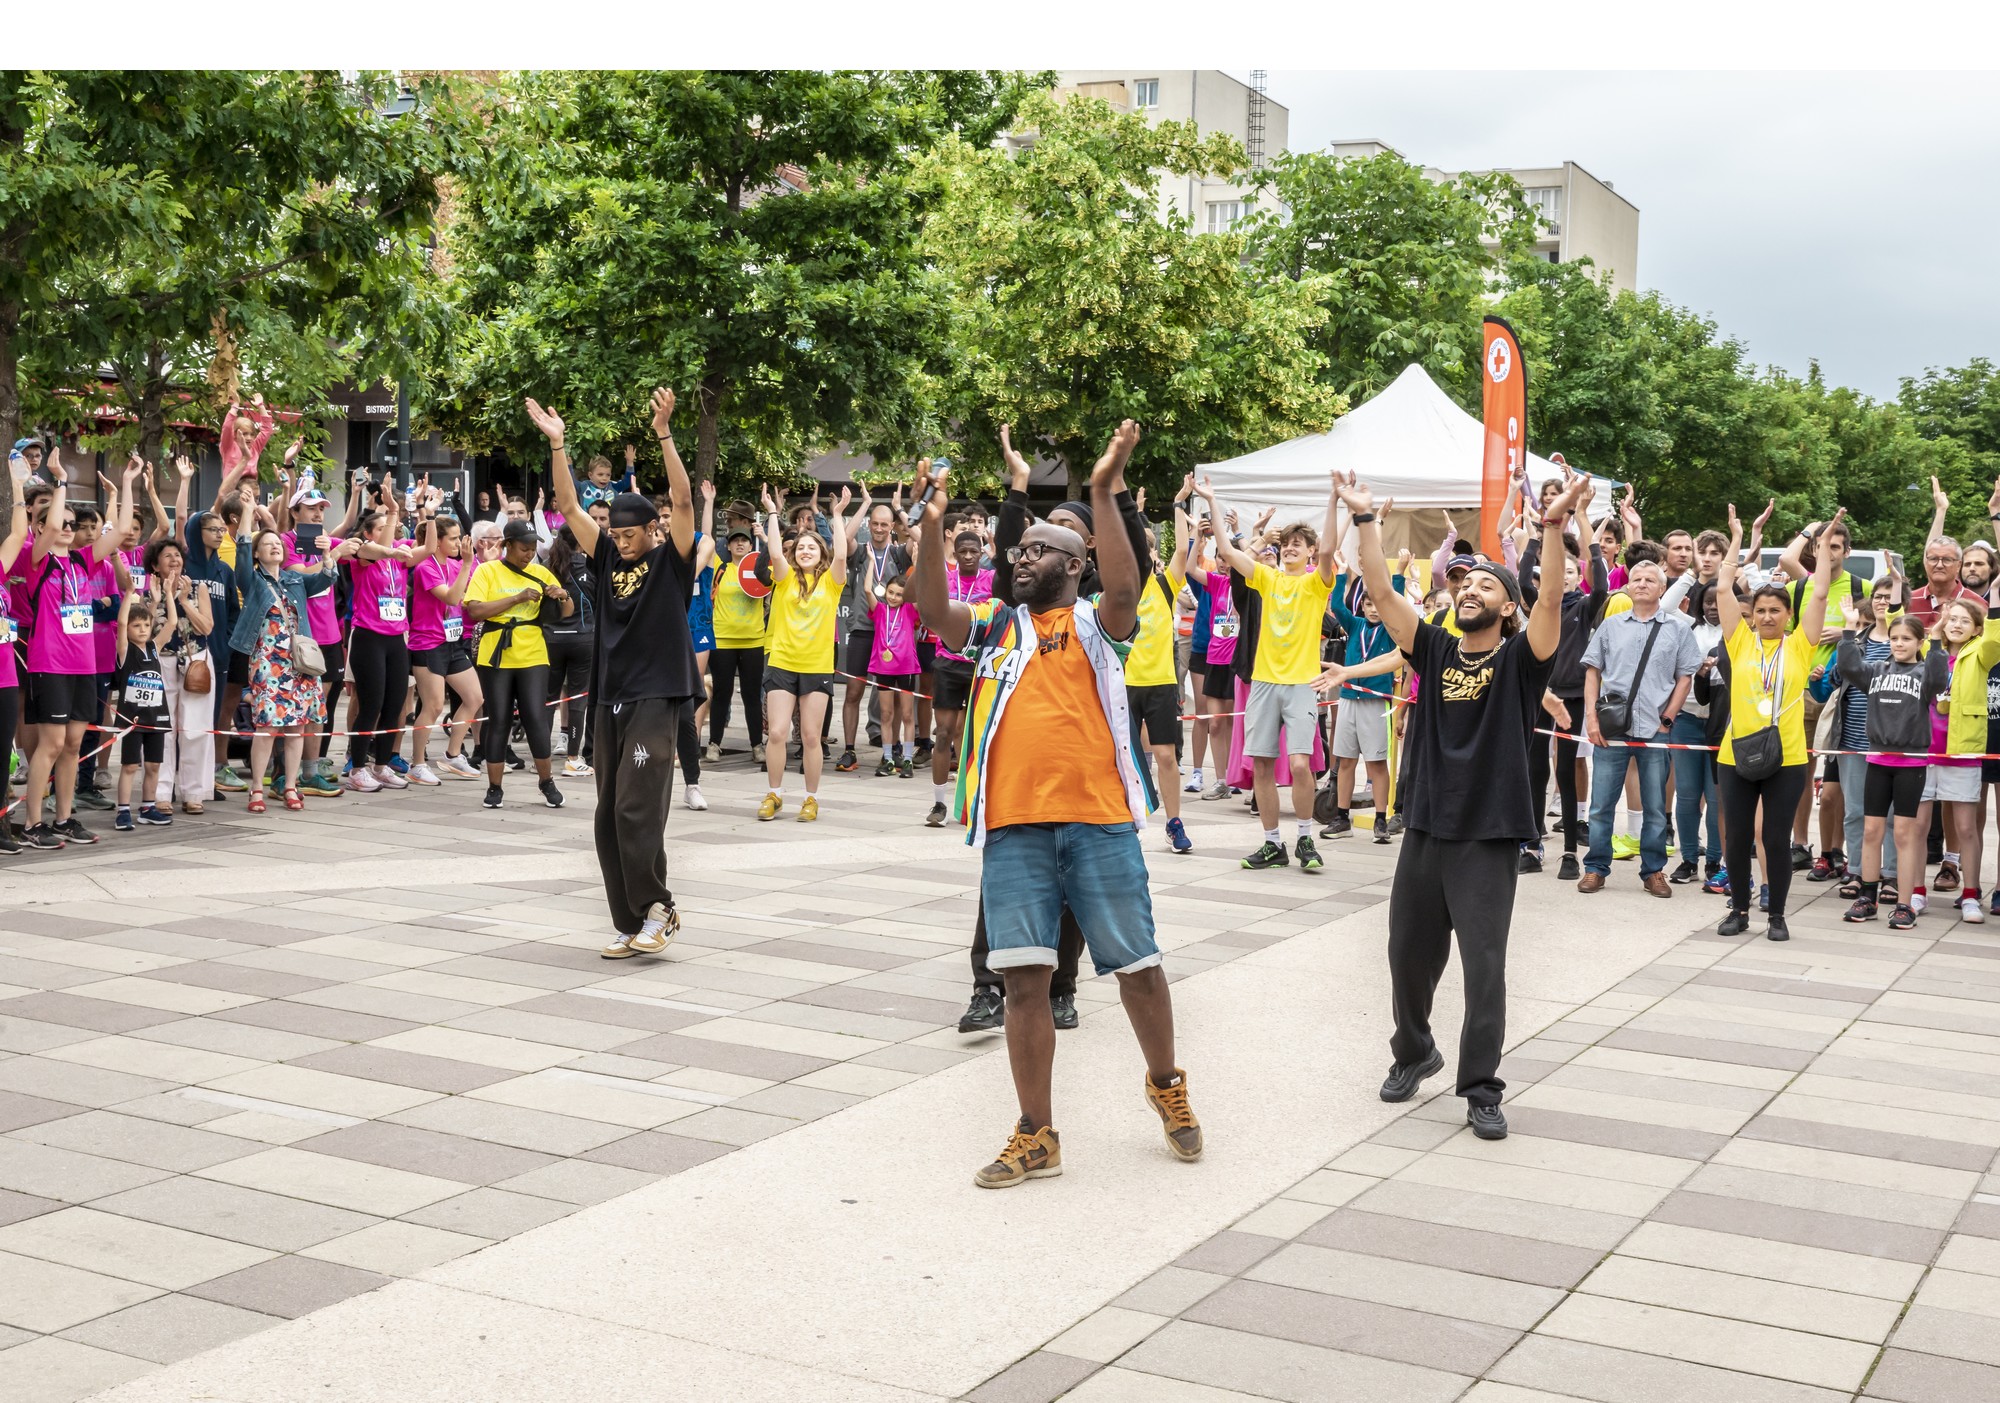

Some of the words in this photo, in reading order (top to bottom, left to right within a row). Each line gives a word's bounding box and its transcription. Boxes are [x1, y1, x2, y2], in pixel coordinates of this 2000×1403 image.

[365, 405, 394, 414] BISTROT
[1442, 667, 1494, 687] URBAN
[135, 689, 155, 701] 361
